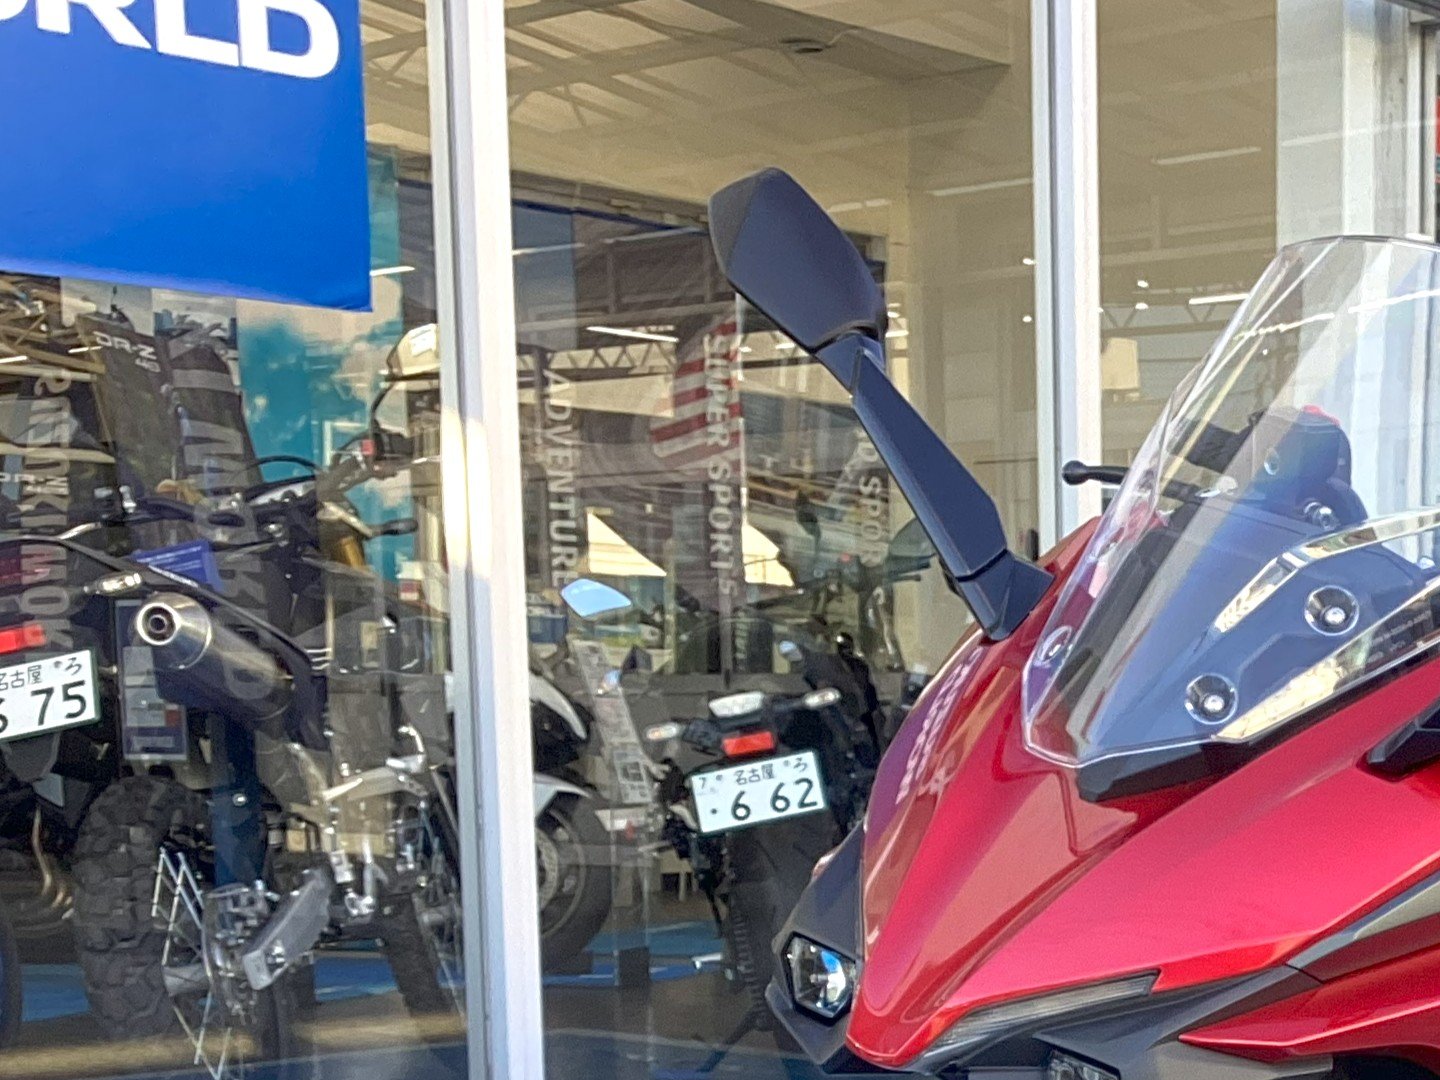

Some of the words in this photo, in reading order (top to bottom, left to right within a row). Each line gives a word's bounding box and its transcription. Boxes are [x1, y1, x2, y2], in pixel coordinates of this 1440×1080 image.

[708, 460, 738, 596] SPORTS
[65, 657, 82, 676] ろ
[734, 763, 774, 785] 名古屋
[793, 757, 808, 773] ろ
